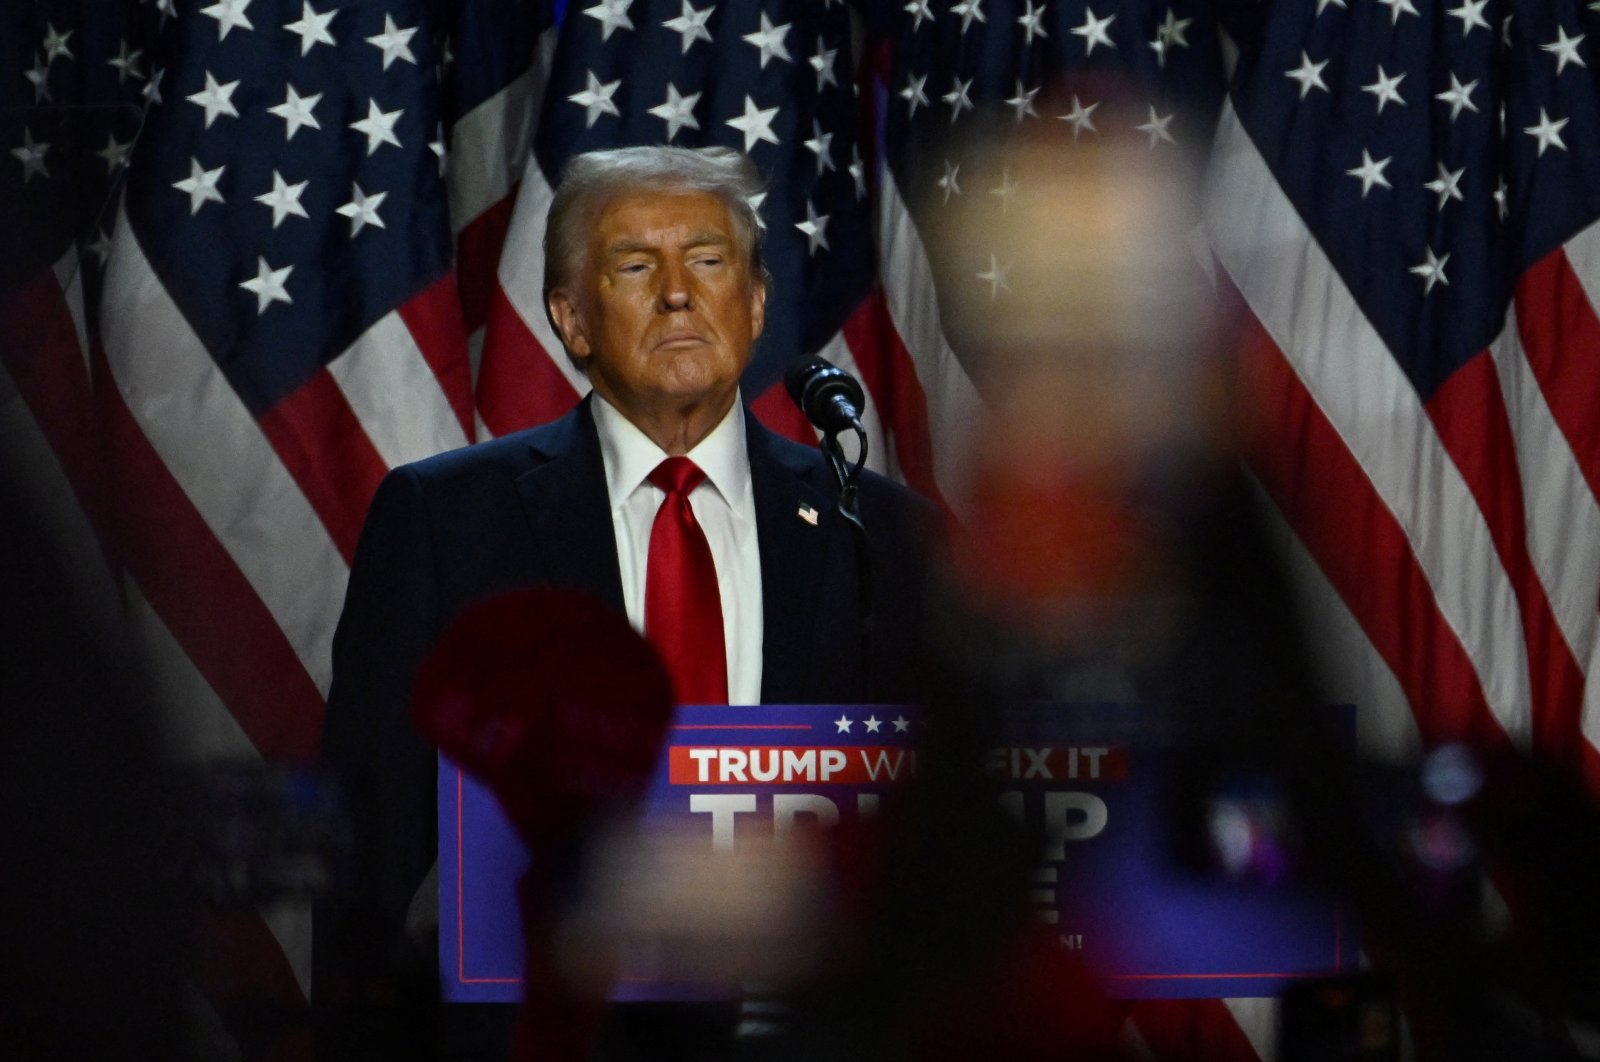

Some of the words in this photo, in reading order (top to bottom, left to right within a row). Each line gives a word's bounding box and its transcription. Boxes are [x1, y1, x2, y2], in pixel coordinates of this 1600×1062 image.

[689, 749, 847, 782] TRUMP
[860, 749, 917, 782] WI
[992, 747, 1056, 779] FIX
[1068, 747, 1109, 779] IT
